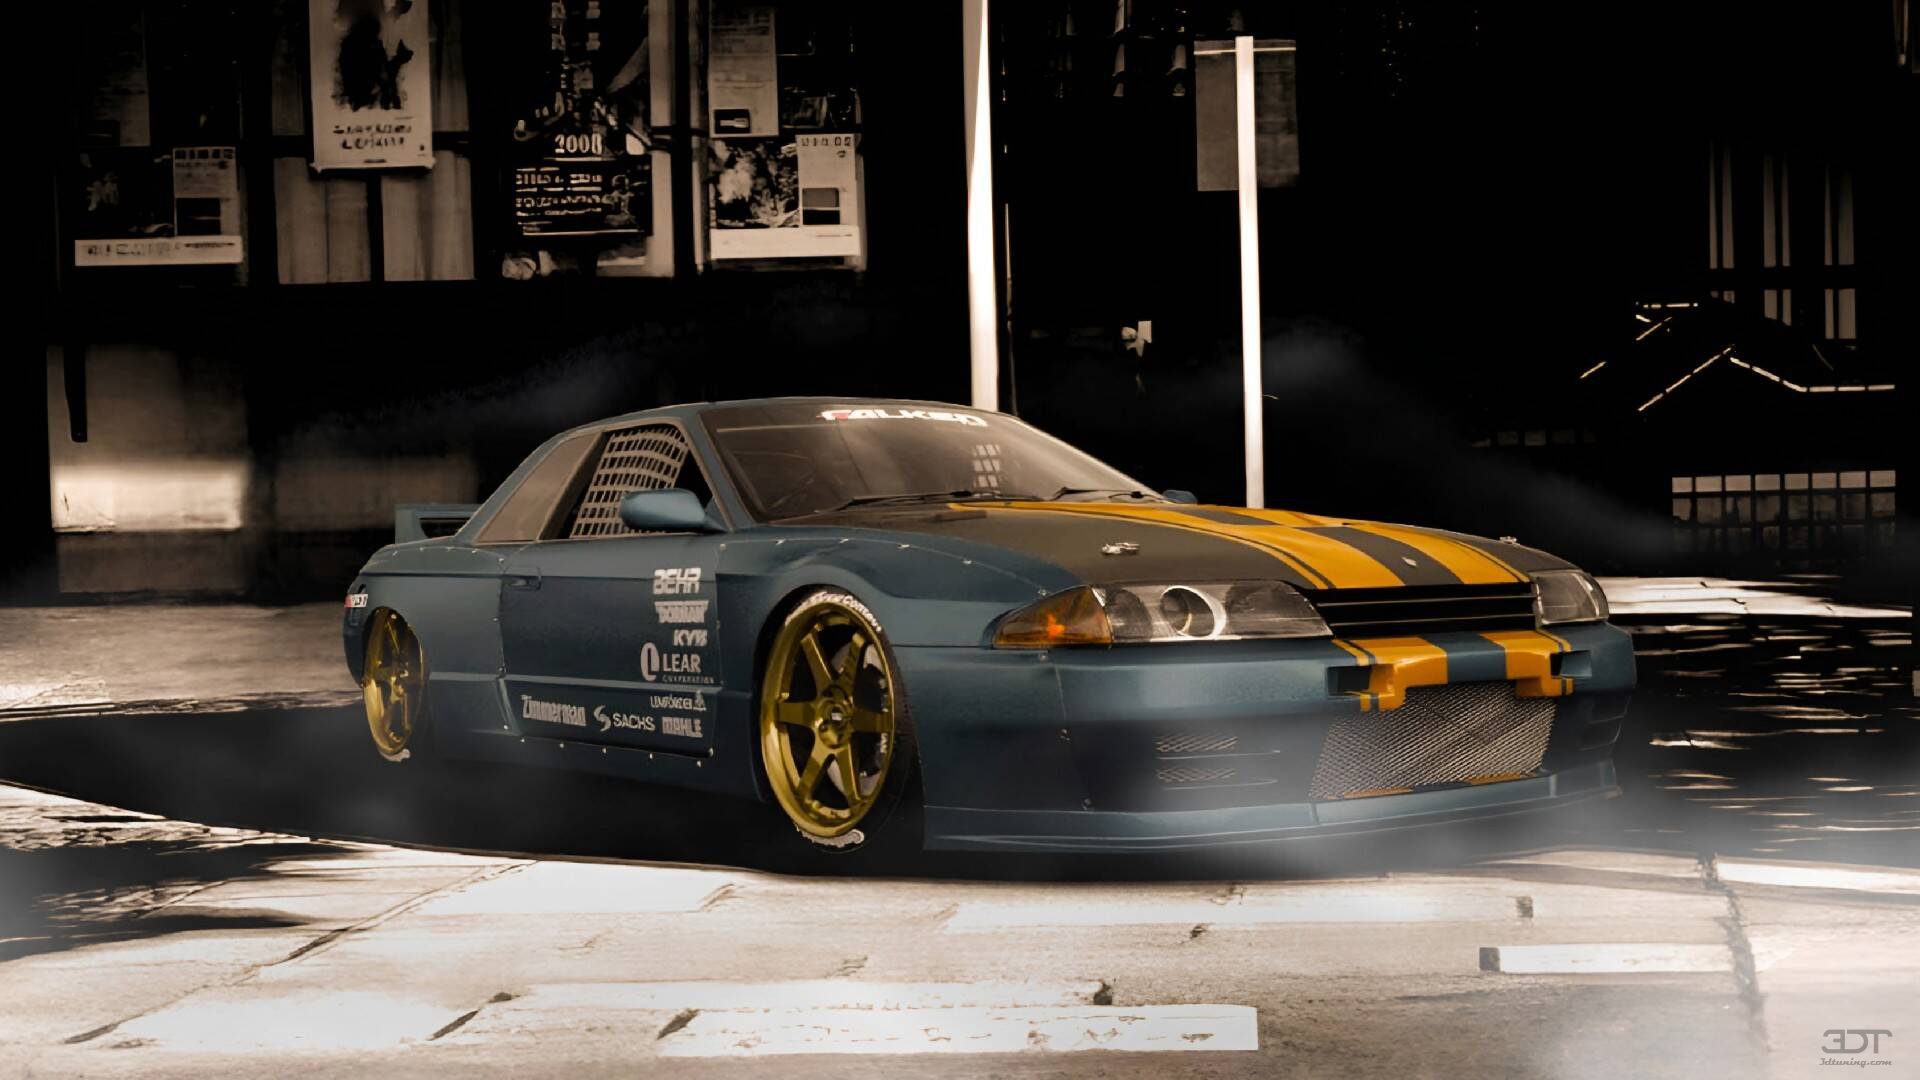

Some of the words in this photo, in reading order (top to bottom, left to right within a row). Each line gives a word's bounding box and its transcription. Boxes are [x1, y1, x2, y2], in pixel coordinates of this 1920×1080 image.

[653, 567, 702, 595] BEHR
[673, 629, 708, 647] KYB
[662, 653, 701, 673] LEAR
[612, 712, 656, 731] SACHS
